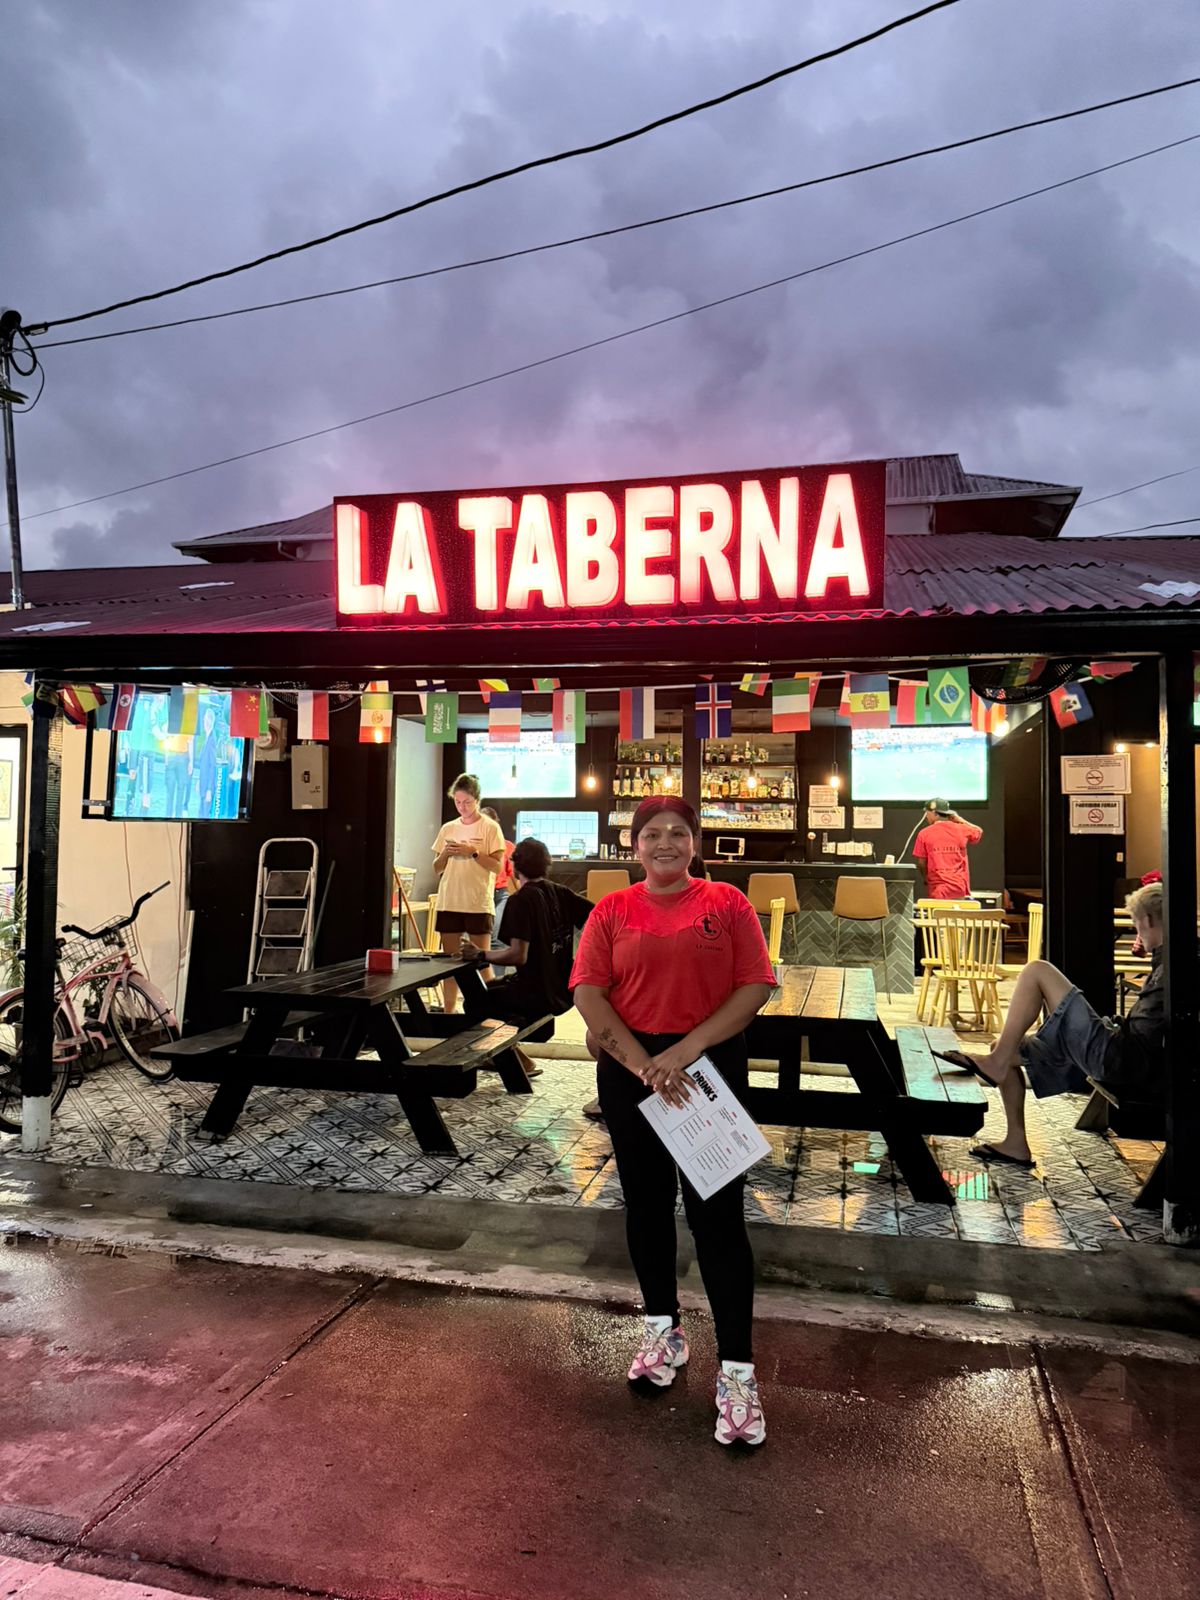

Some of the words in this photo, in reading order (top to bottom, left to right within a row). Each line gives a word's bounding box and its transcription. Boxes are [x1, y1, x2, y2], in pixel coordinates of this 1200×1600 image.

[336, 502, 443, 614] LA
[458, 473, 870, 611] TABERNA
[692, 1070, 718, 1102] DRINKS
